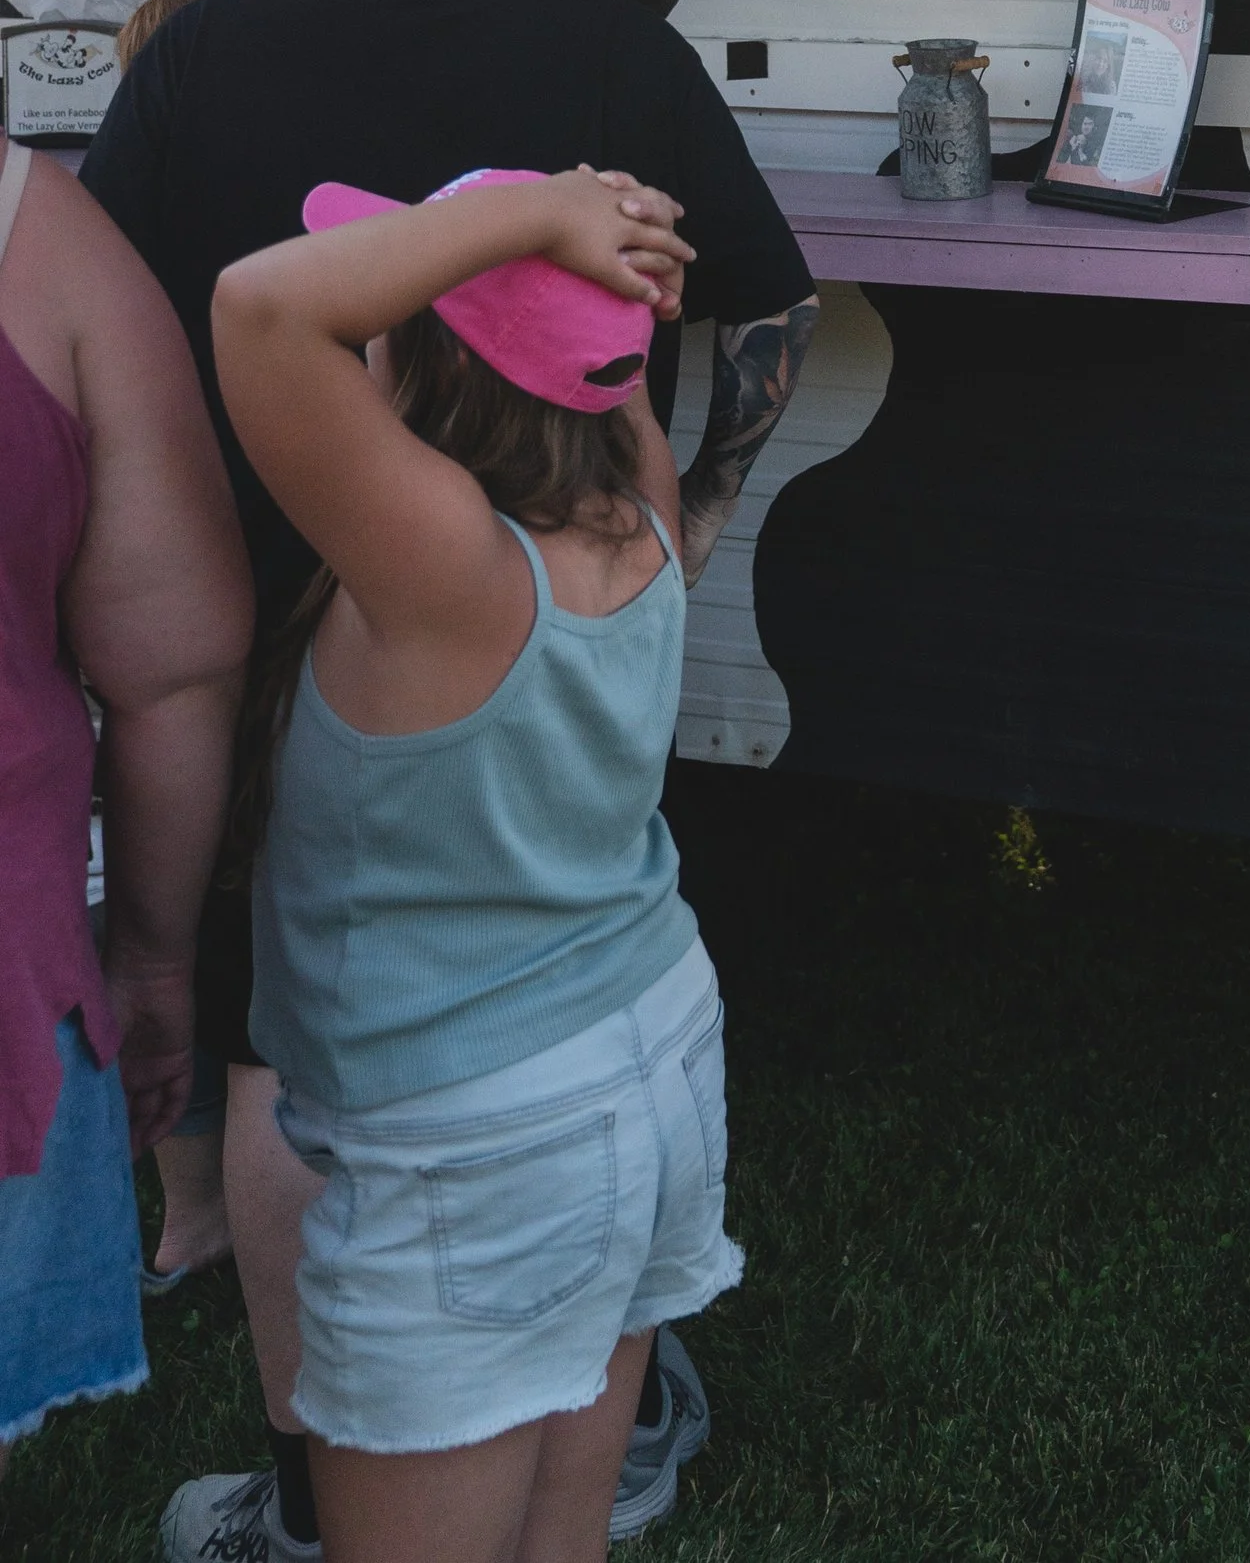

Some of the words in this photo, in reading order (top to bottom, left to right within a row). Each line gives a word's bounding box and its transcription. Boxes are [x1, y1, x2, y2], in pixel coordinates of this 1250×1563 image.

[18, 61, 44, 81] The
[47, 73, 84, 86] Lazy
[23, 109, 41, 118] Like
[42, 110, 53, 118] us
[54, 110, 66, 118] on
[899, 109, 936, 136] OW
[17, 122, 34, 131] The
[36, 122, 54, 132] Lazy
[56, 121, 75, 131] Cow
[77, 121, 101, 130] Verm
